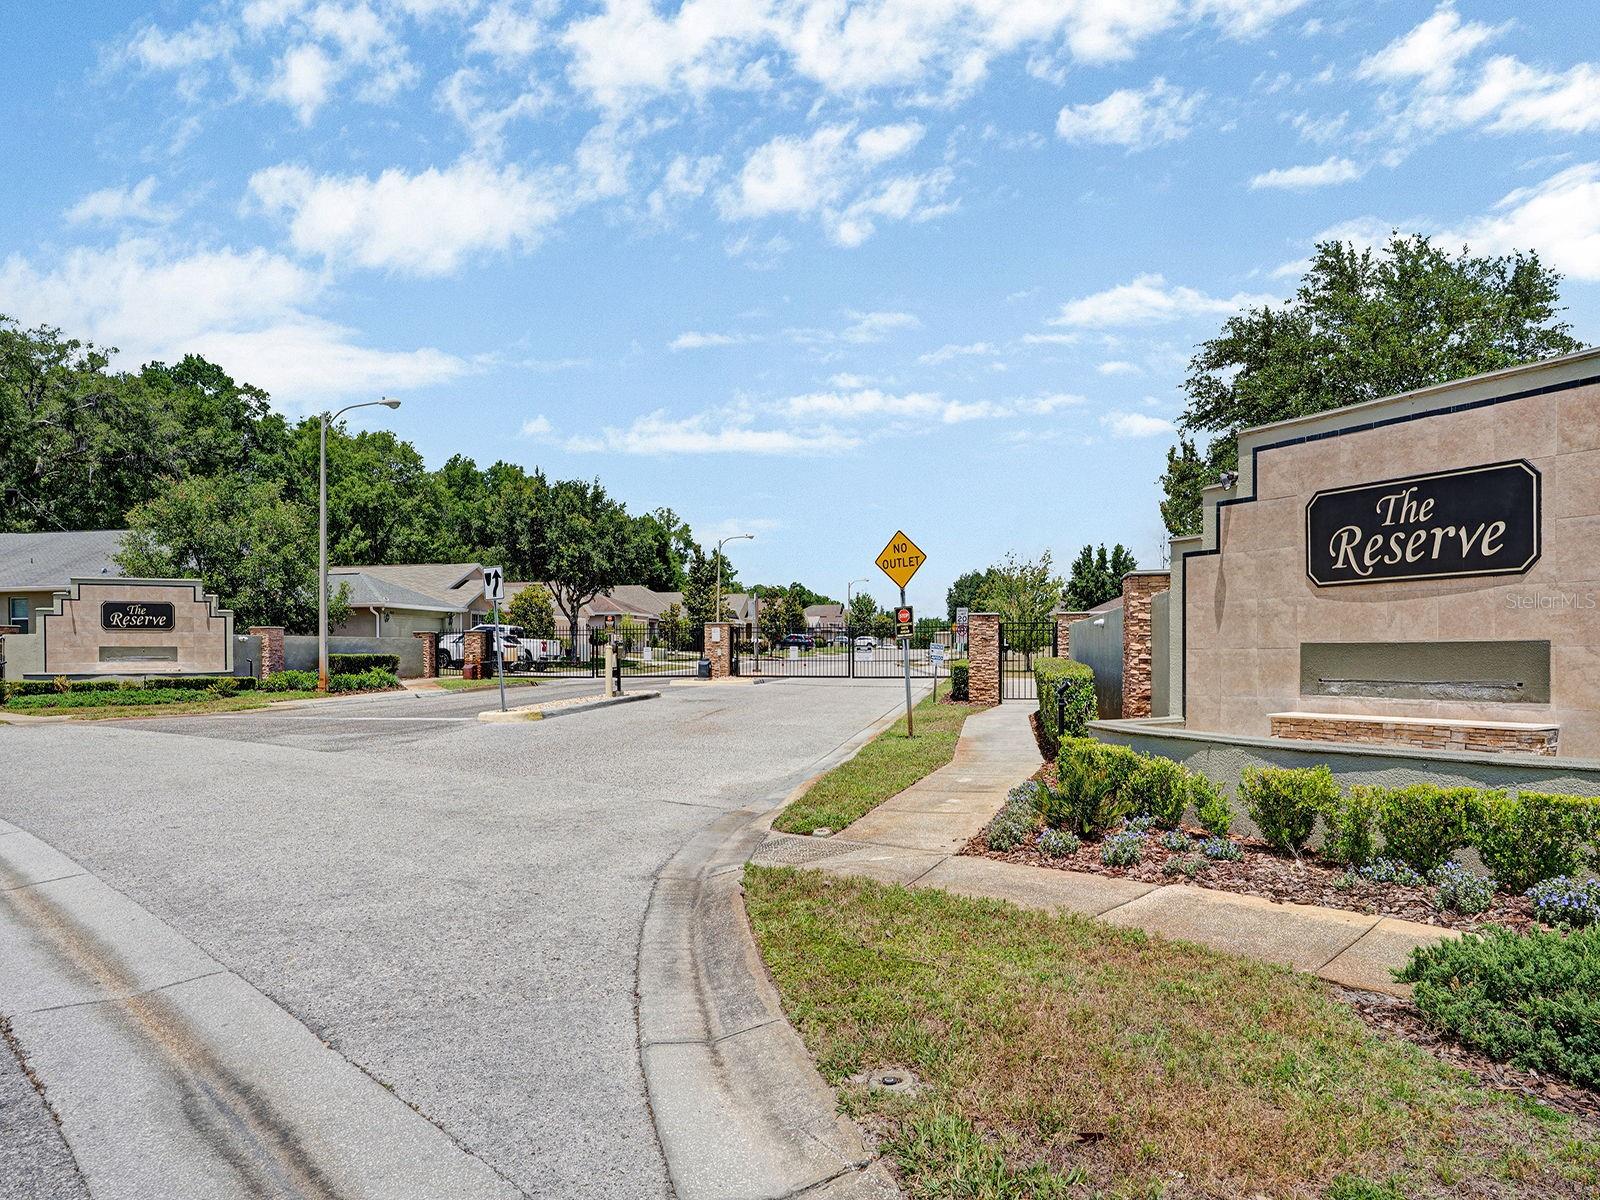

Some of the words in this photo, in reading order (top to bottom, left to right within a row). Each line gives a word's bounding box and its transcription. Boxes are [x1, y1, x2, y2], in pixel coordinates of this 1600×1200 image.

[1376, 486, 1435, 527] The
[893, 543, 908, 554] NO
[1329, 520, 1507, 577] Reserve
[882, 556, 920, 569] OUTLET
[127, 604, 147, 615] The
[109, 612, 167, 628] Reserve
